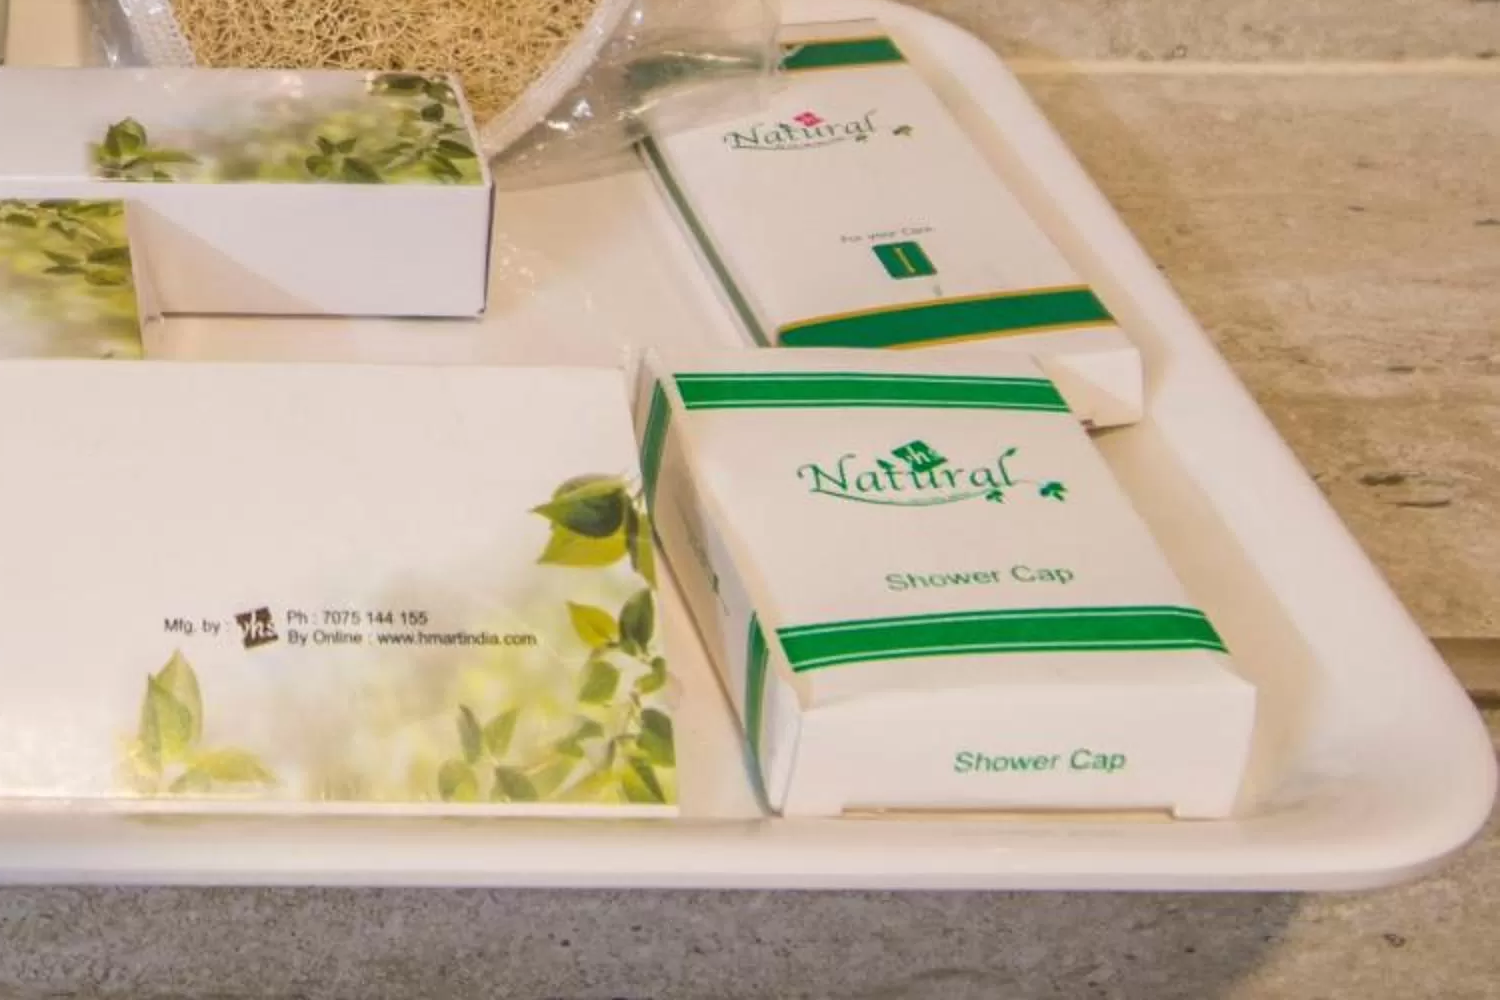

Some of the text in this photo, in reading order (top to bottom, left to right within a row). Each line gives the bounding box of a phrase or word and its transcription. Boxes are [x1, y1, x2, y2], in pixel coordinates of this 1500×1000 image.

[723, 109, 877, 146] Natural
[797, 447, 1018, 493] Natural
[885, 565, 1074, 592] Shower Cap
[164, 618, 221, 635] Mfg. by
[287, 610, 428, 625] Ph 7075 144 155
[287, 630, 537, 646] By Online www.hmartindia.com
[954, 747, 1127, 774] Shower Cap
